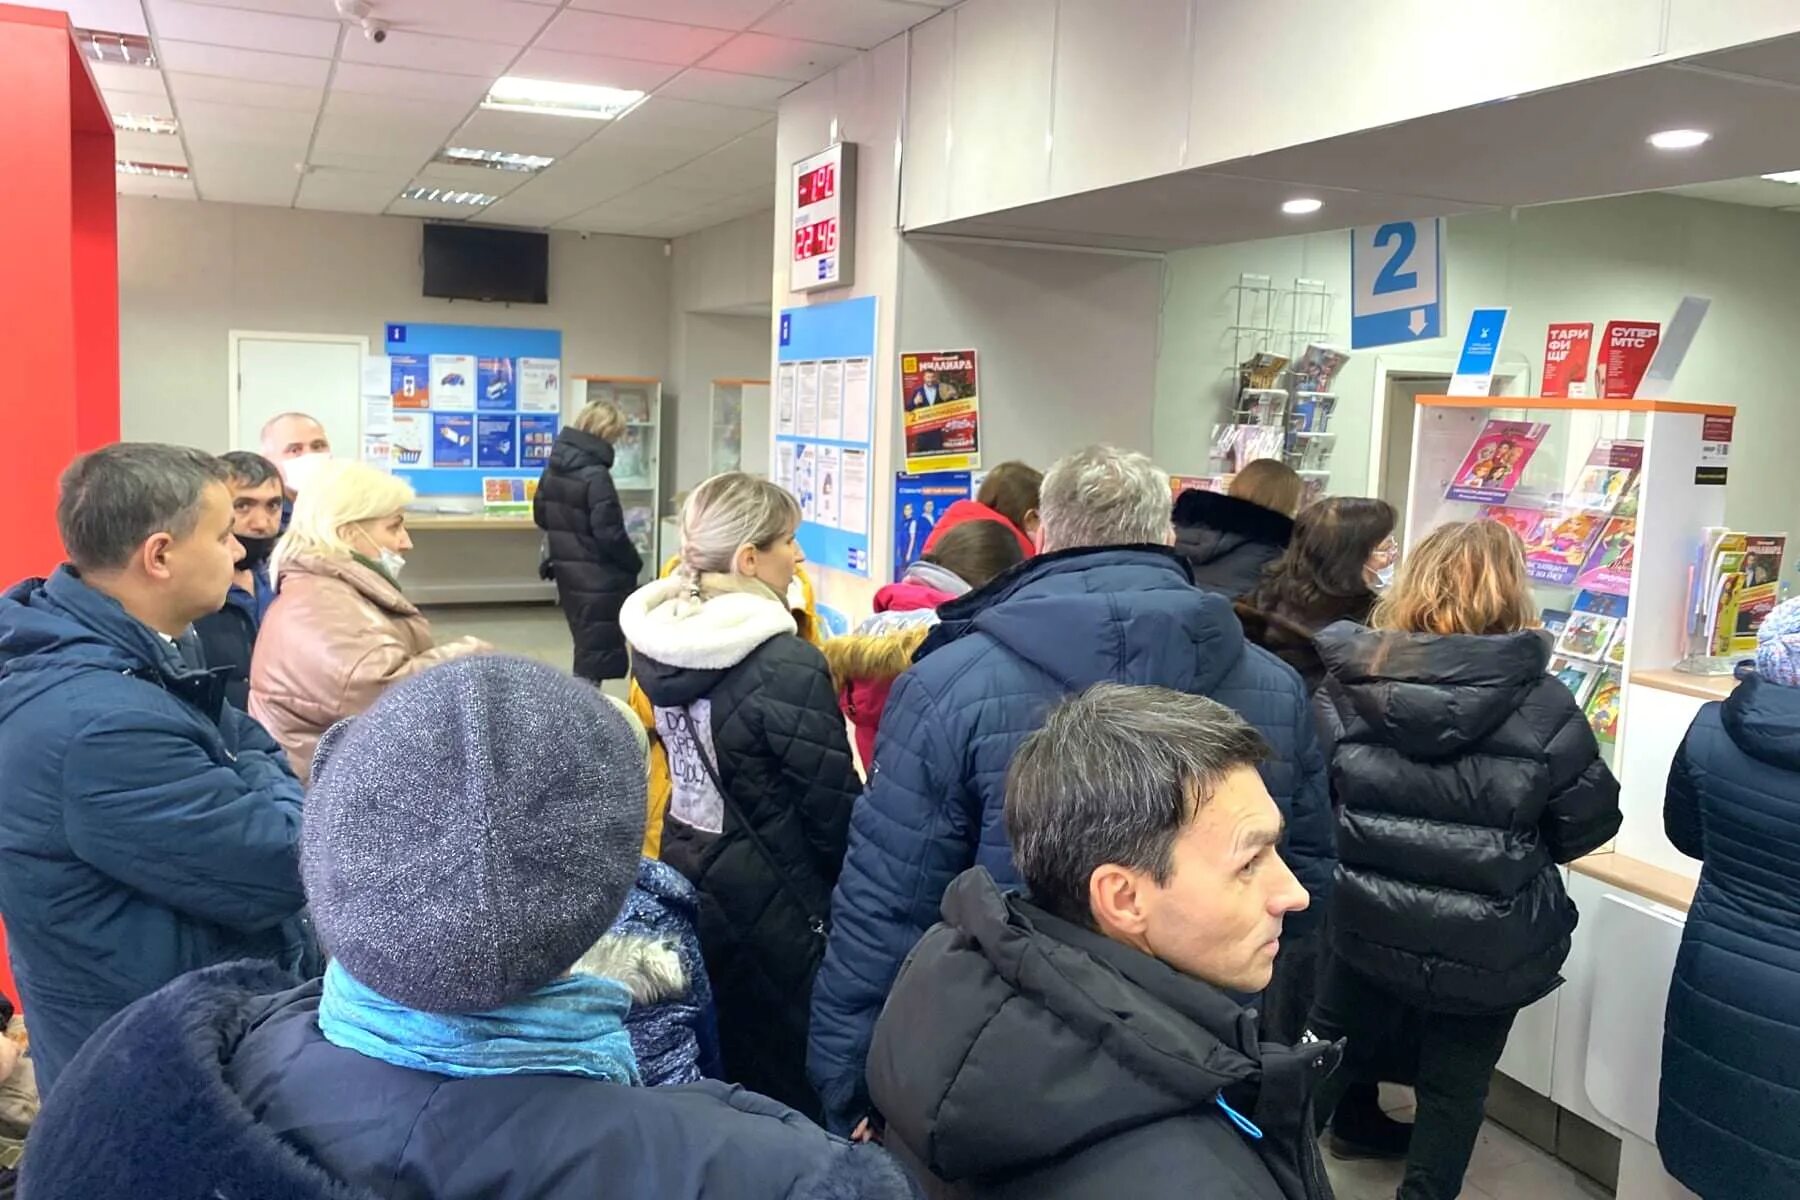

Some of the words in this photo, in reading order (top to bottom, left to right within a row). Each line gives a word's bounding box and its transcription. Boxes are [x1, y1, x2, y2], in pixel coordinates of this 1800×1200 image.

[1373, 221, 1417, 295] 2
[1550, 329, 1589, 340] ТАРИ
[1612, 327, 1658, 337] СУПЕР
[1548, 340, 1571, 350] ФИ
[1611, 338, 1645, 348] МТС
